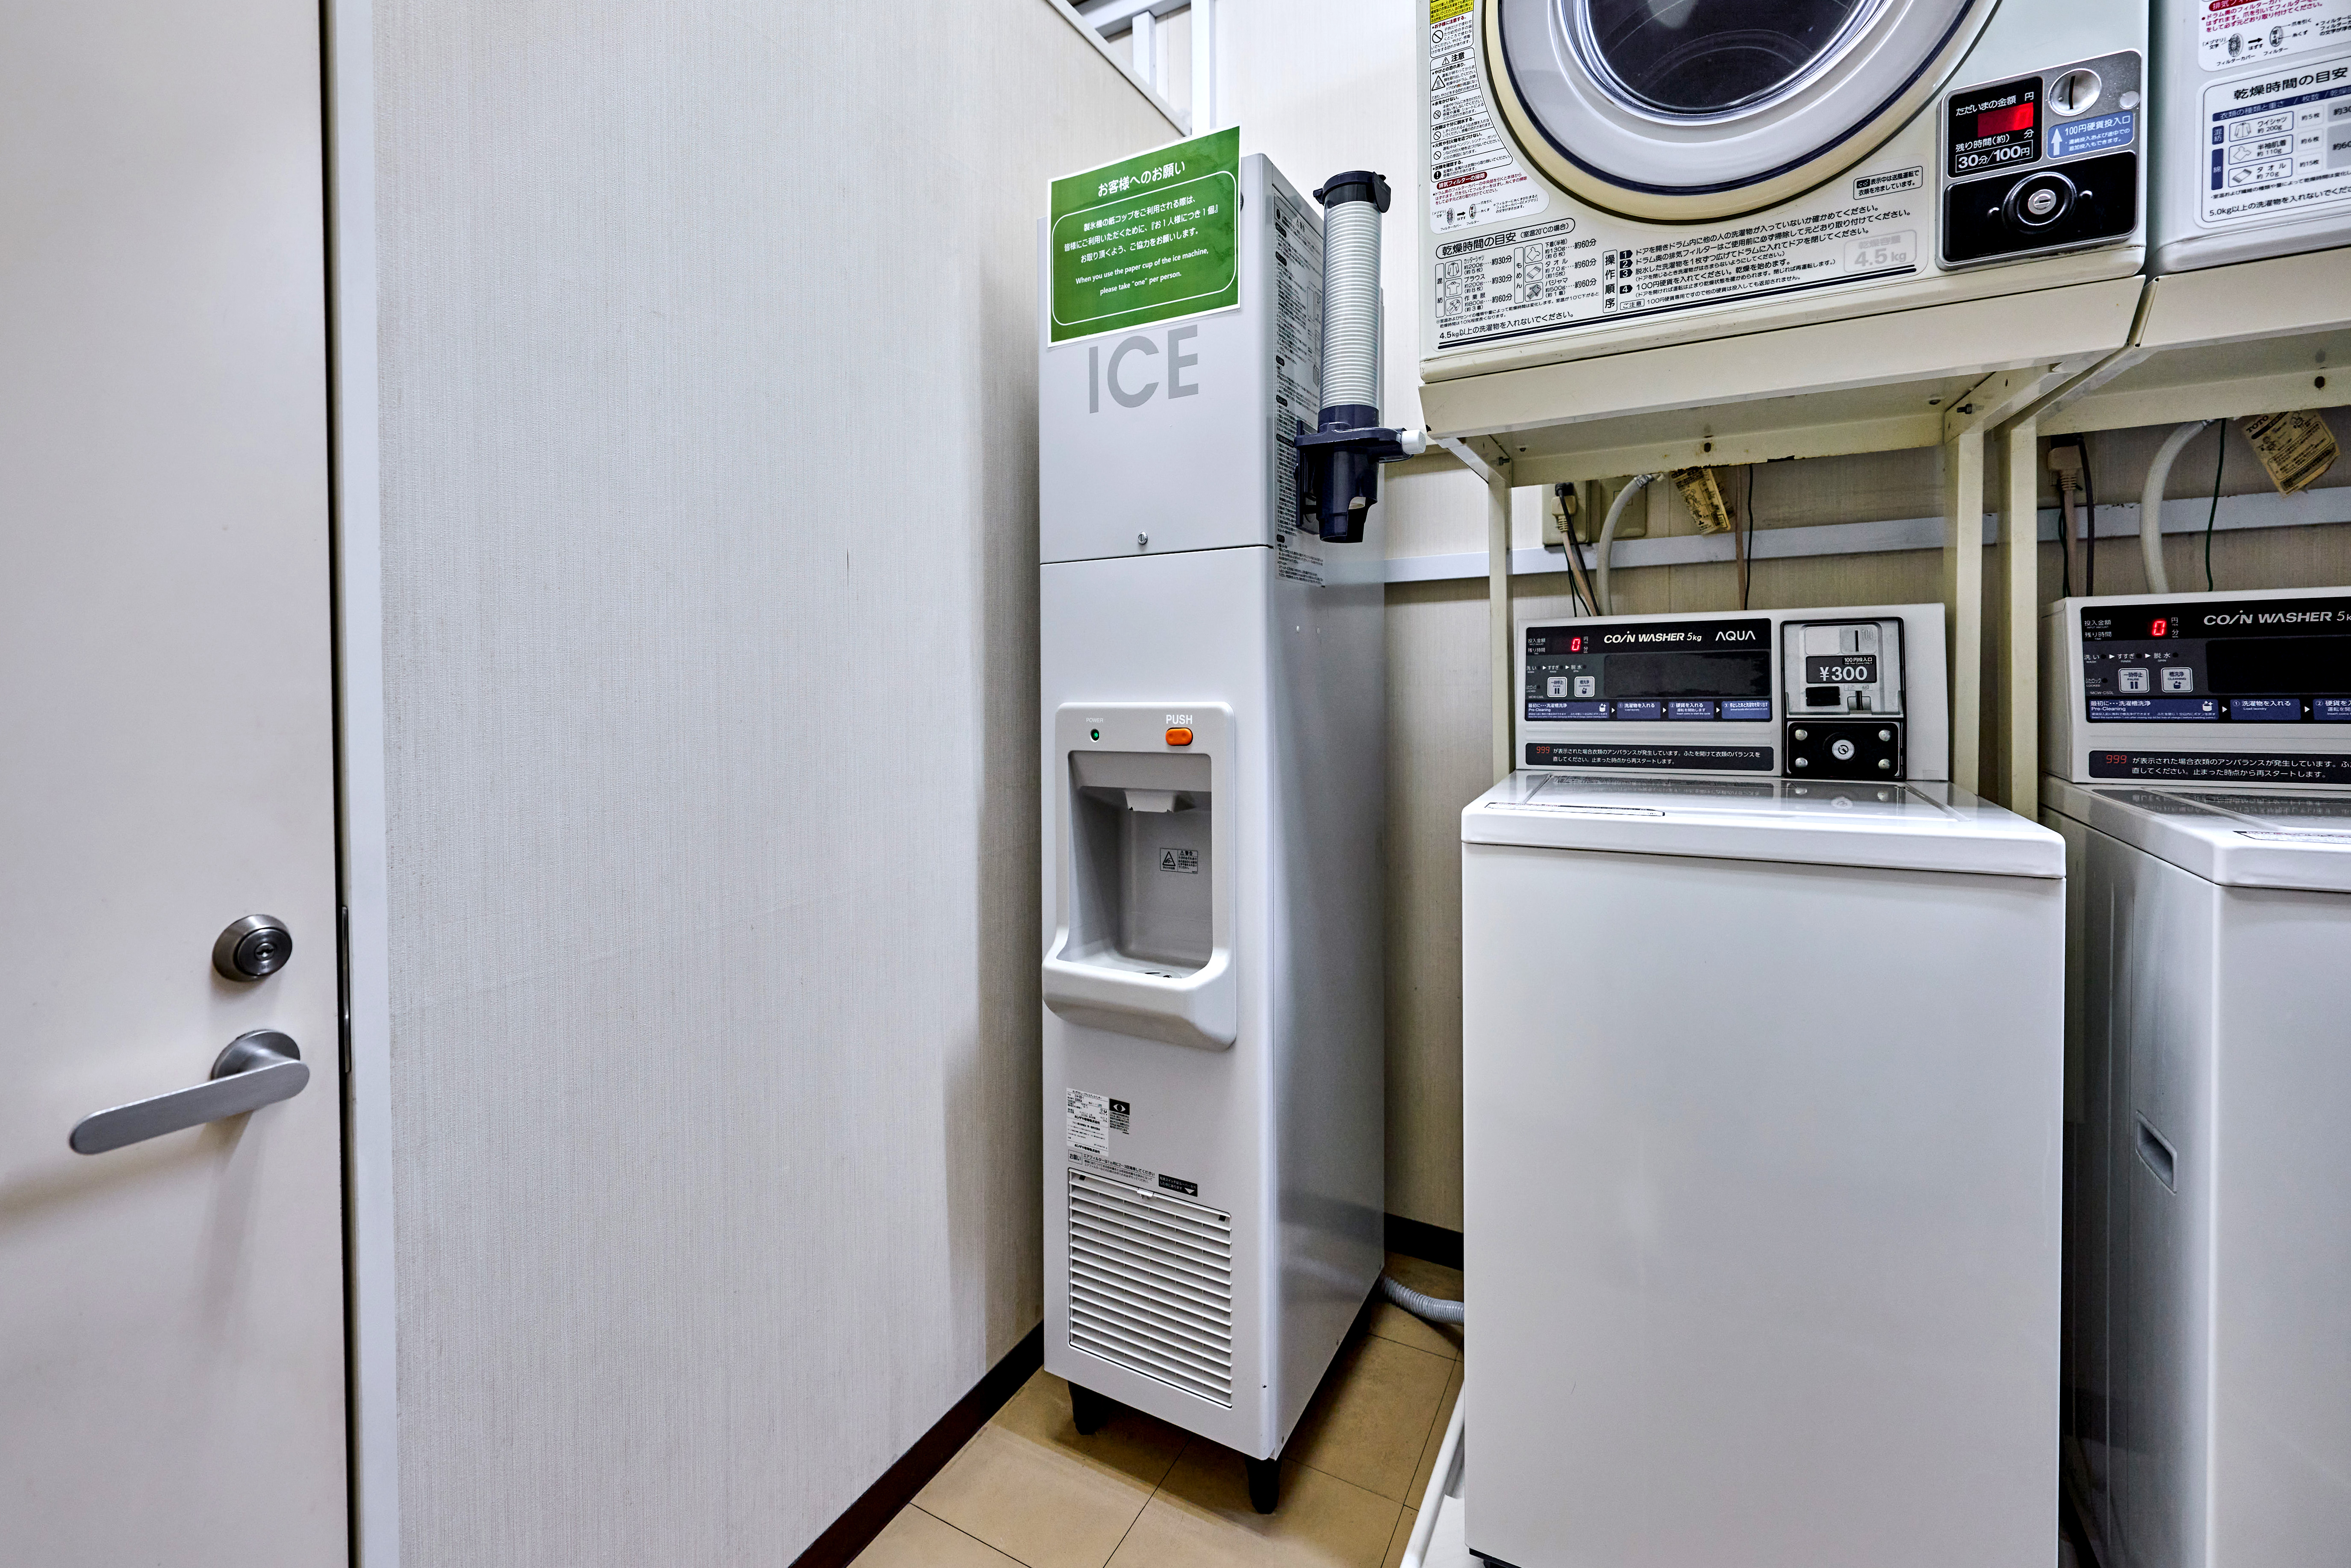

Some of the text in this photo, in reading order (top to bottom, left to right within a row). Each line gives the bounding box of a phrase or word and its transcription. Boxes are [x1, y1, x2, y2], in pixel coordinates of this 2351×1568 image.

[1451, 52, 1464, 62] 注意
[2263, 47, 2288, 56] フィルター
[2217, 55, 2255, 66] フィルターカバー
[1435, 63, 1465, 74] やけどの恐れあり。
[2233, 67, 2348, 100] 乾燥時間の目安
[1435, 96, 1459, 106] 水をかけない。
[1956, 92, 2034, 116] ただいまの金額 円
[2221, 94, 2319, 120] 衣類の種類と重さ 枚数
[1435, 117, 1474, 130] 衣類は十分に脱水する。
[2065, 115, 2130, 135] 100円硬貨投入口
[2257, 116, 2287, 127] ワイシャツ
[1435, 132, 1482, 147] 火気や引火物を近づけない。
[1956, 129, 2034, 152] 残り時間(約) 分
[2069, 137, 2121, 151] 追加投入もできます。
[2257, 139, 2286, 150] 半袖肌着
[1958, 146, 2030, 168] 30分/100円
[1435, 161, 1463, 170] 衣類を確認する。
[1098, 161, 1185, 197] お客様へのお願い
[1439, 173, 1485, 188] 排気フィルターの掃除
[1871, 170, 1919, 185] 表示中は送風運転で
[1859, 180, 1915, 196] 衣類を冷ましています。
[1084, 195, 1195, 232] 製氷機の紙コップをご利用される際は、
[1636, 205, 1878, 256] ドアを開きドラム内に他の人の洗濯物が入っていないか確かめてください。
[1636, 209, 1910, 265] ドラム奥の排気フィルターはご使用前に必ず掃除して元どおり取り付けてください。
[1081, 227, 1198, 263] お取り頂くよう、ご協力をお願いします。
[1443, 232, 1516, 256] 乾燥時間の目安
[1575, 238, 1597, 249] 約60分
[1859, 235, 1901, 249] 乾燥容量
[1635, 227, 1868, 275] 脱水した洗濯物を1枚ずつ広げてドラムに入れてドアを閉じてください。
[1854, 248, 1906, 267] 4.5 kg
[1125, 264, 1141, 274] paper
[1182, 248, 1208, 259] machine,
[1464, 255, 1484, 264] カッターシャツ
[1492, 256, 1512, 265] 約30分
[1575, 259, 1597, 269] 約60分
[1100, 286, 1117, 296] please
[1132, 278, 1147, 286] "one"
[1160, 271, 1181, 282] person.
[1464, 274, 1485, 282] ブラウス
[1492, 274, 1512, 284] 約30分
[1545, 277, 1568, 286] パジャマ
[1575, 278, 1597, 288] 約60分
[1605, 255, 1615, 309] 操作順序
[1492, 294, 1512, 303] 約60分
[1440, 311, 1573, 339] 4.5kg以上の洗濯物を入れないでください。
[1089, 324, 1199, 414] ICE
[2246, 415, 2269, 433] TOTO
[2204, 610, 2253, 625] COIN
[2259, 612, 2332, 623] WASHER
[2153, 621, 2165, 635] 0
[1572, 638, 1580, 650] 0
[1604, 631, 1756, 644] COIN WASHER 5kg AQUA
[1820, 666, 1867, 681] ¥300
[1166, 714, 1193, 724] PUSH
[2106, 755, 2127, 764] 999
[2132, 767, 2325, 778] 直してください。止まった時点から再スタートします。
